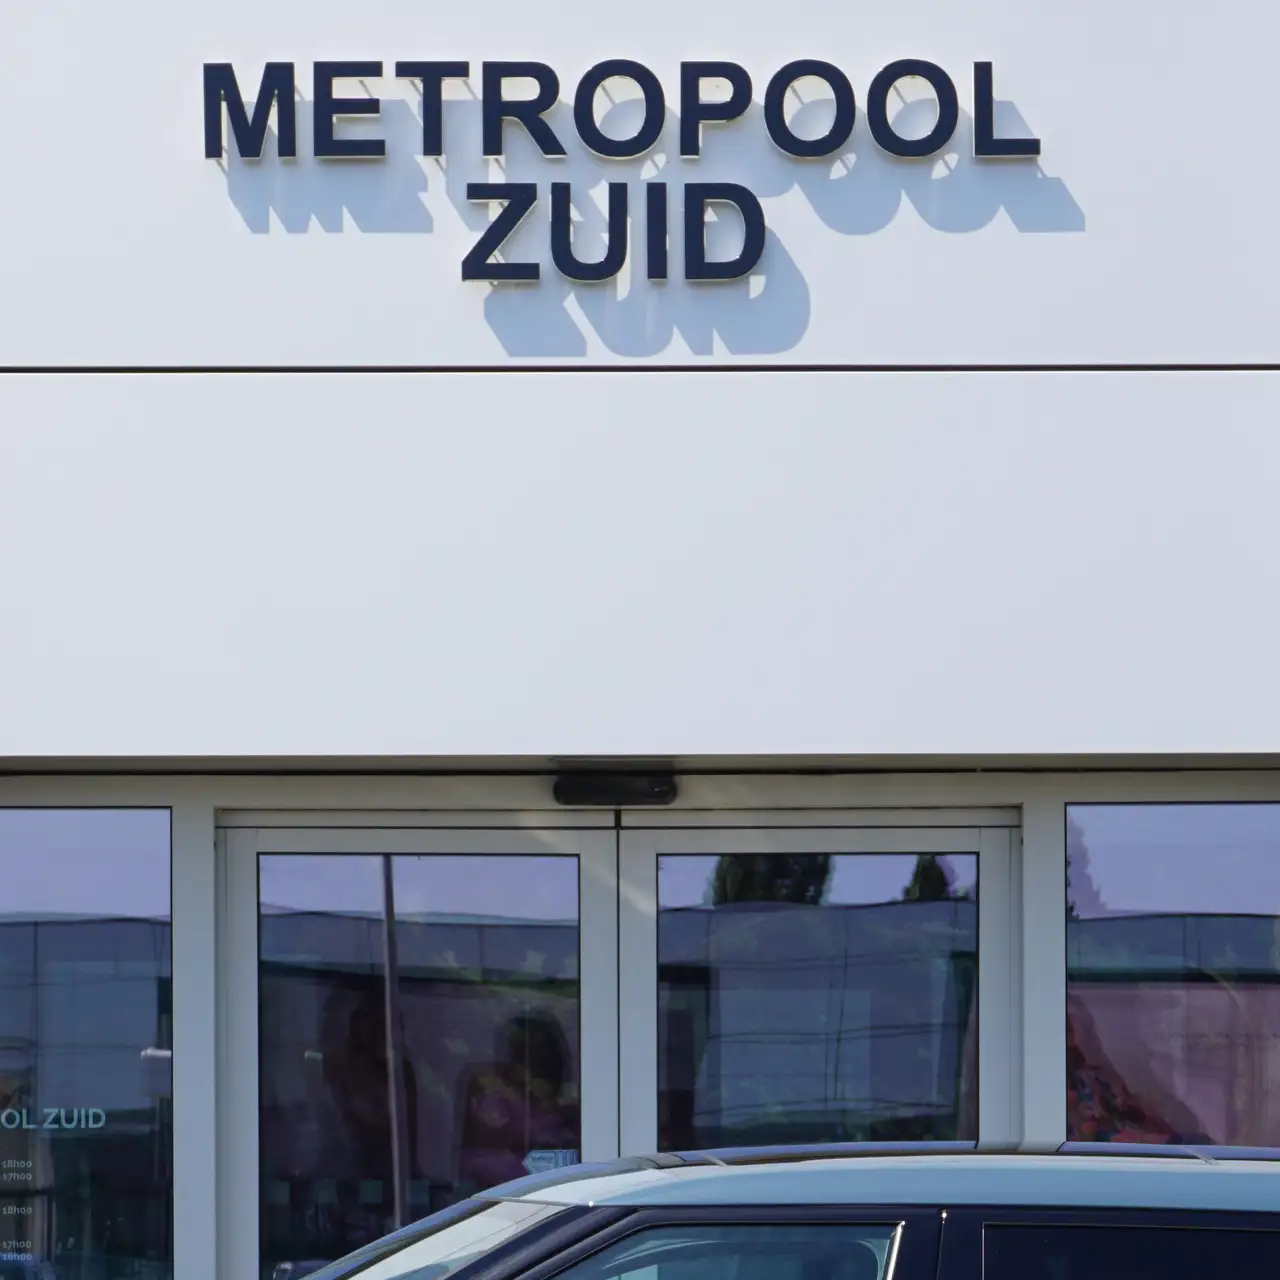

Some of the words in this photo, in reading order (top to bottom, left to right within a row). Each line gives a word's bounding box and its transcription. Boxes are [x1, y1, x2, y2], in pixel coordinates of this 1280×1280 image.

[204, 58, 1040, 158] METROPOOL
[461, 182, 766, 281] ZUID
[43, 1107, 107, 1130] ZUID
[2, 1159, 33, 1168] 18h00
[2, 1172, 33, 1182] 17h00
[2, 1206, 33, 1215] 18h00
[2, 1240, 33, 1251] 17h00
